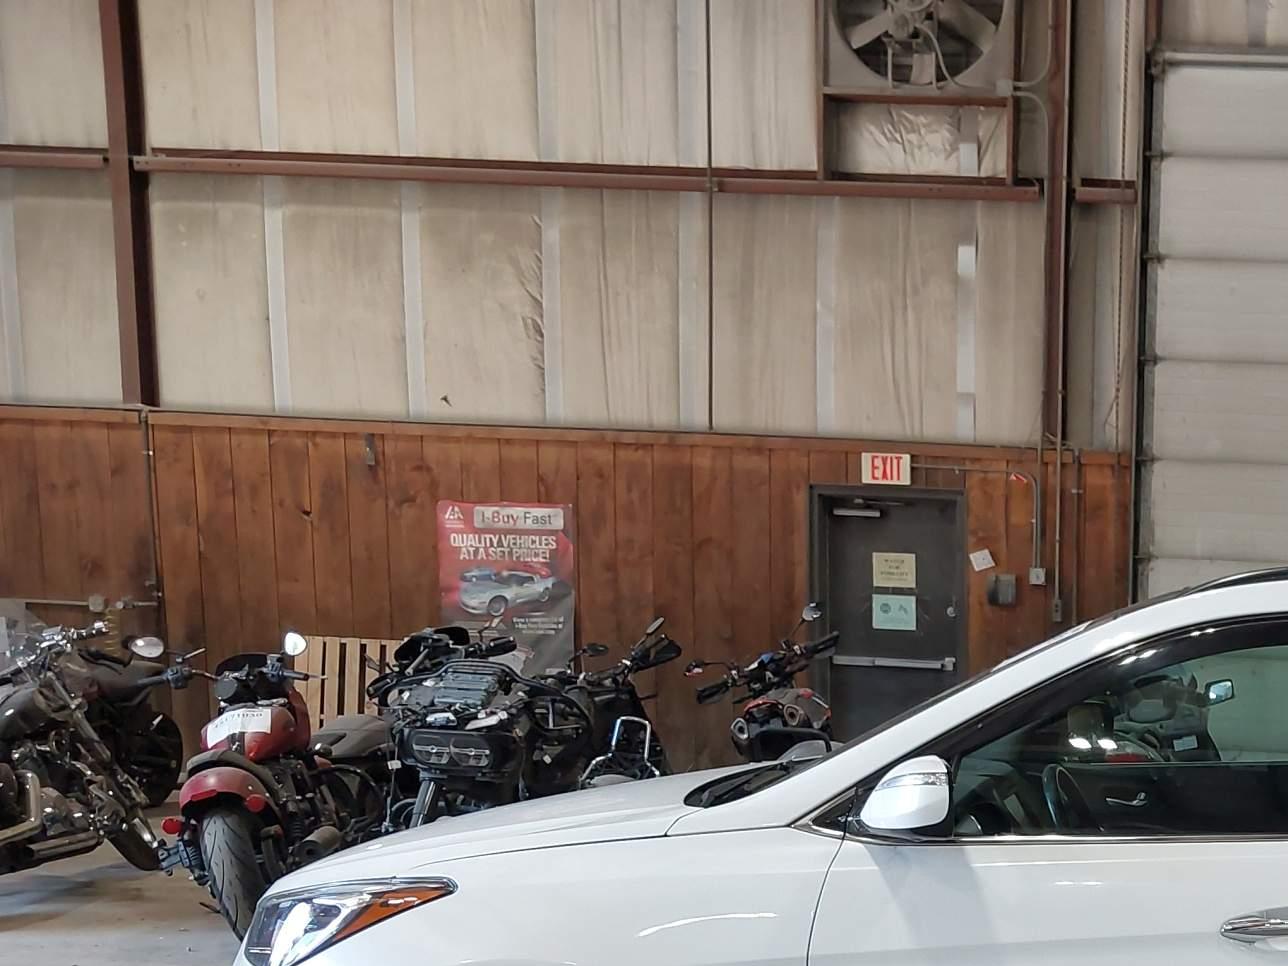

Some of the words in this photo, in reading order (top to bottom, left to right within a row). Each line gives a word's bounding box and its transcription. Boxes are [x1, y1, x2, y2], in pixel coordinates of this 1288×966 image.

[871, 455, 903, 480] EXIT
[523, 511, 552, 525] Fast
[450, 533, 499, 547] QUALITY
[500, 534, 557, 549] VEHICLES
[460, 547, 476, 560] AT
[476, 547, 486, 560] A
[488, 548, 511, 561] SET
[512, 548, 550, 562] PRICE!
